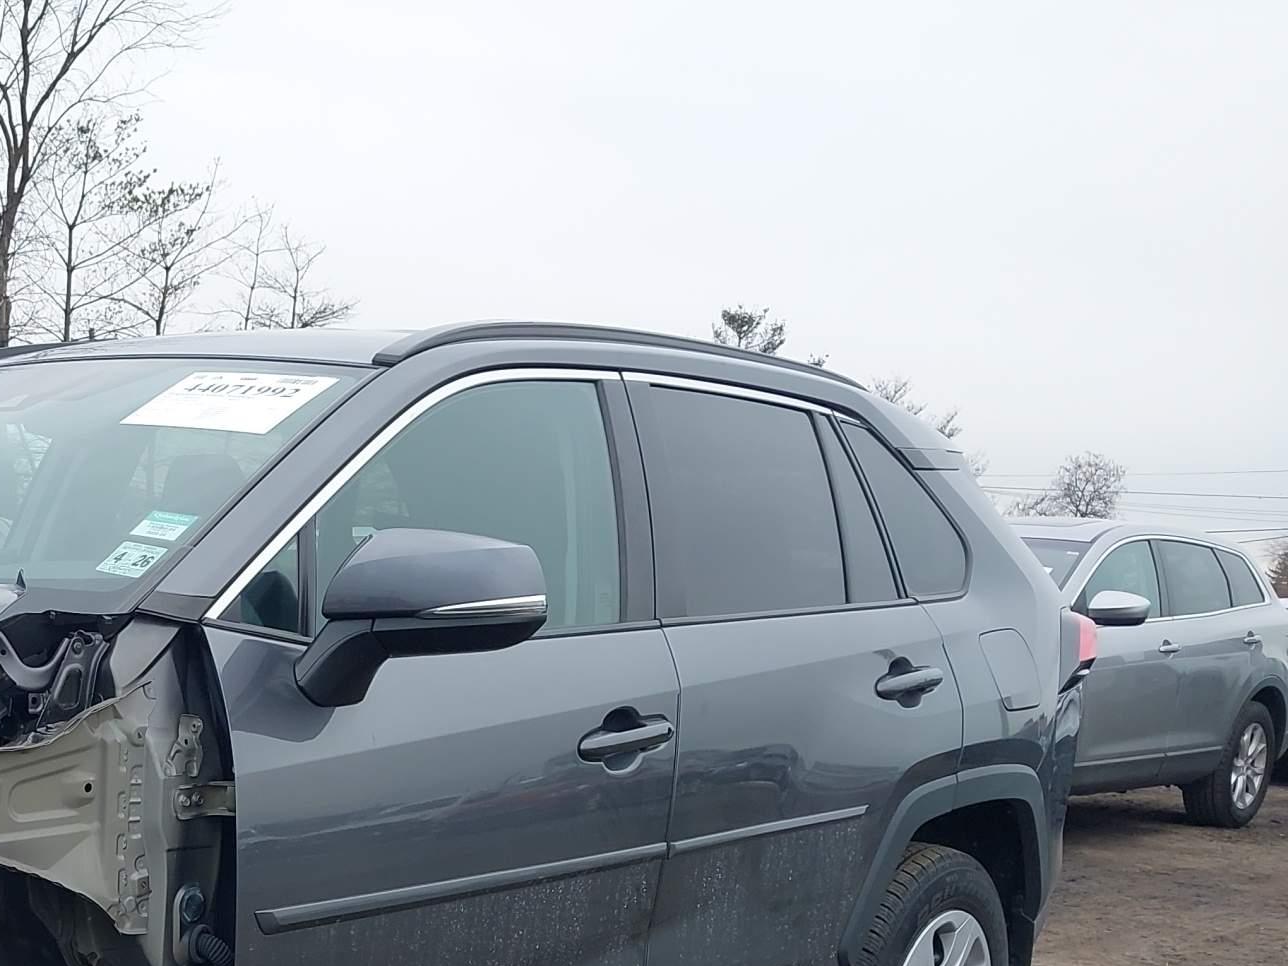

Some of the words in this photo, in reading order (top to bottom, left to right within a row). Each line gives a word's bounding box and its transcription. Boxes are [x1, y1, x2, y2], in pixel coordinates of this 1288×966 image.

[184, 383, 300, 398] 44071992
[113, 551, 129, 564] 4
[132, 554, 155, 568] 26
